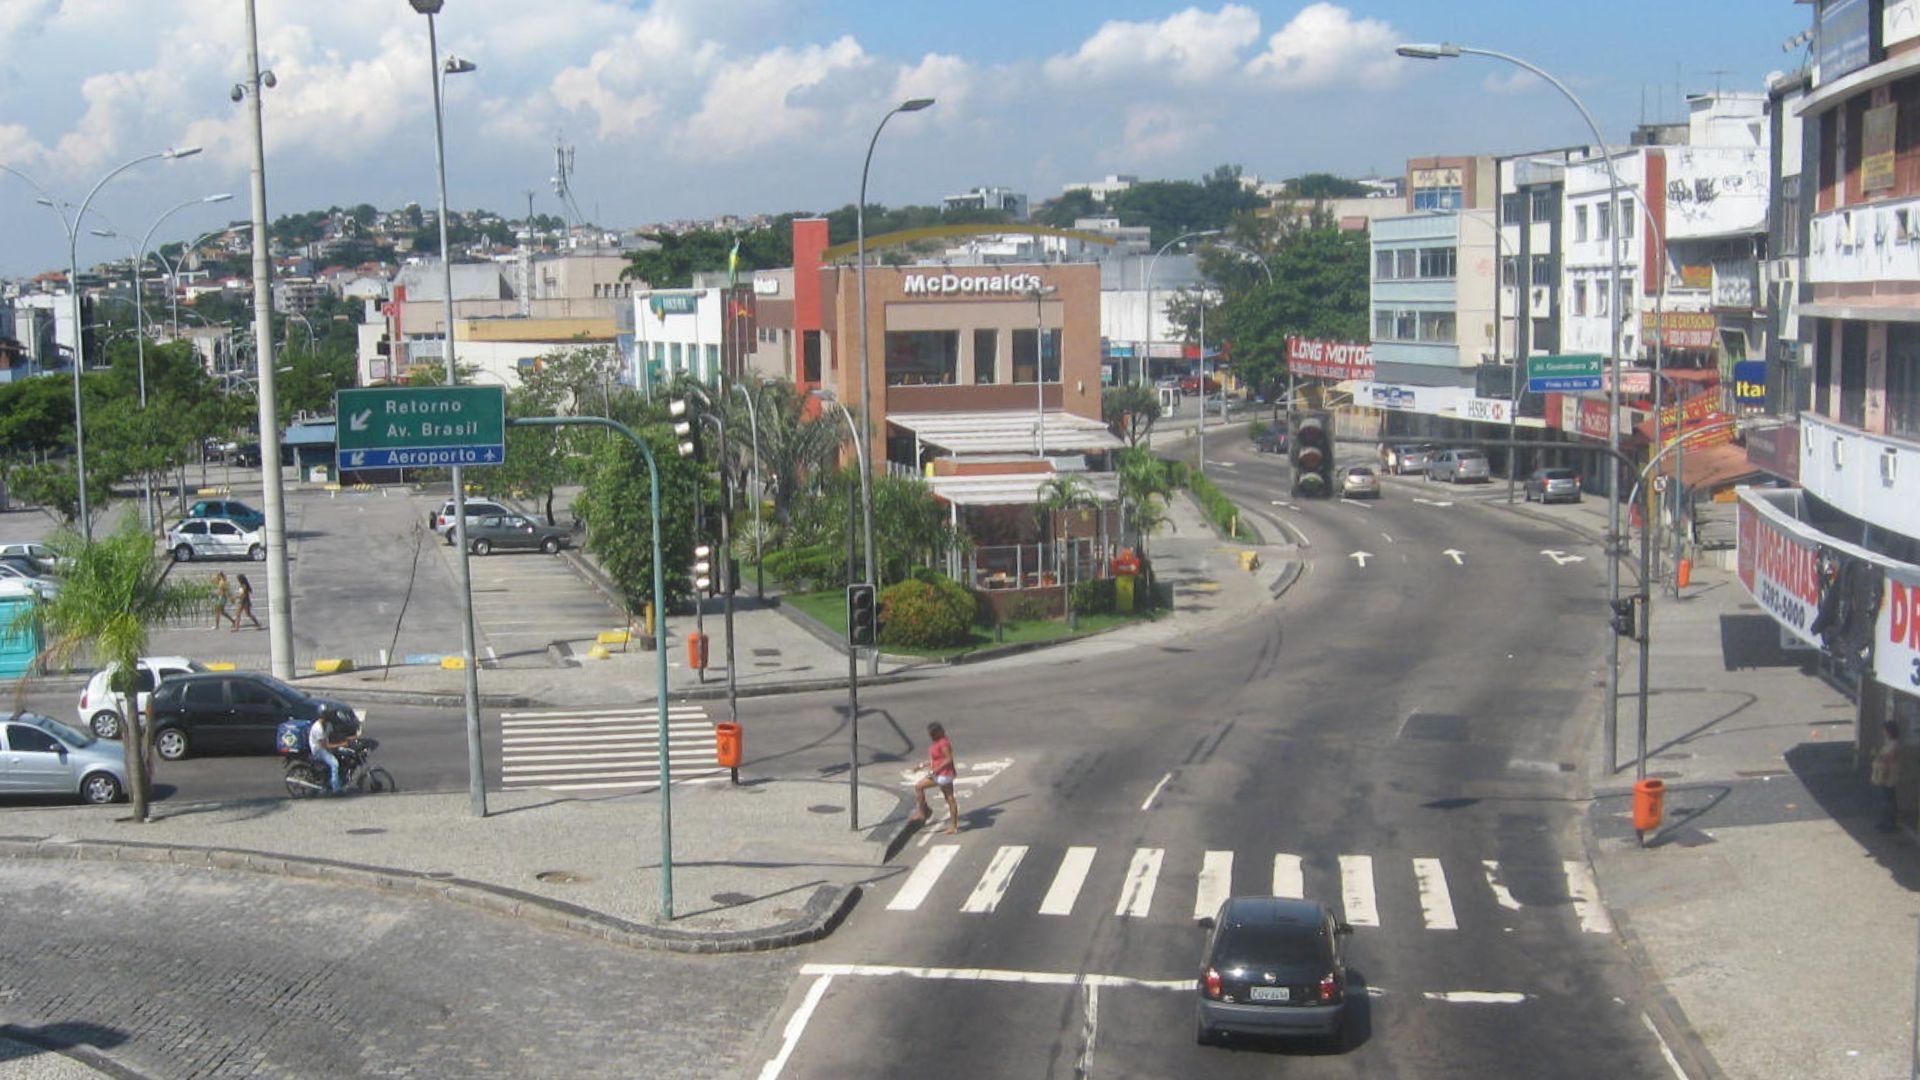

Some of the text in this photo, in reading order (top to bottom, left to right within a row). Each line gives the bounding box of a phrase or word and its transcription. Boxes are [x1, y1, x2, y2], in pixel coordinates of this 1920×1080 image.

[903, 273, 1041, 294] McDonald's
[1291, 338, 1322, 361] LONG
[386, 399, 462, 415] Retorno
[1467, 400, 1491, 419] HSBC
[387, 421, 479, 438] Av. Brasil
[387, 450, 477, 465] Aeroporto
